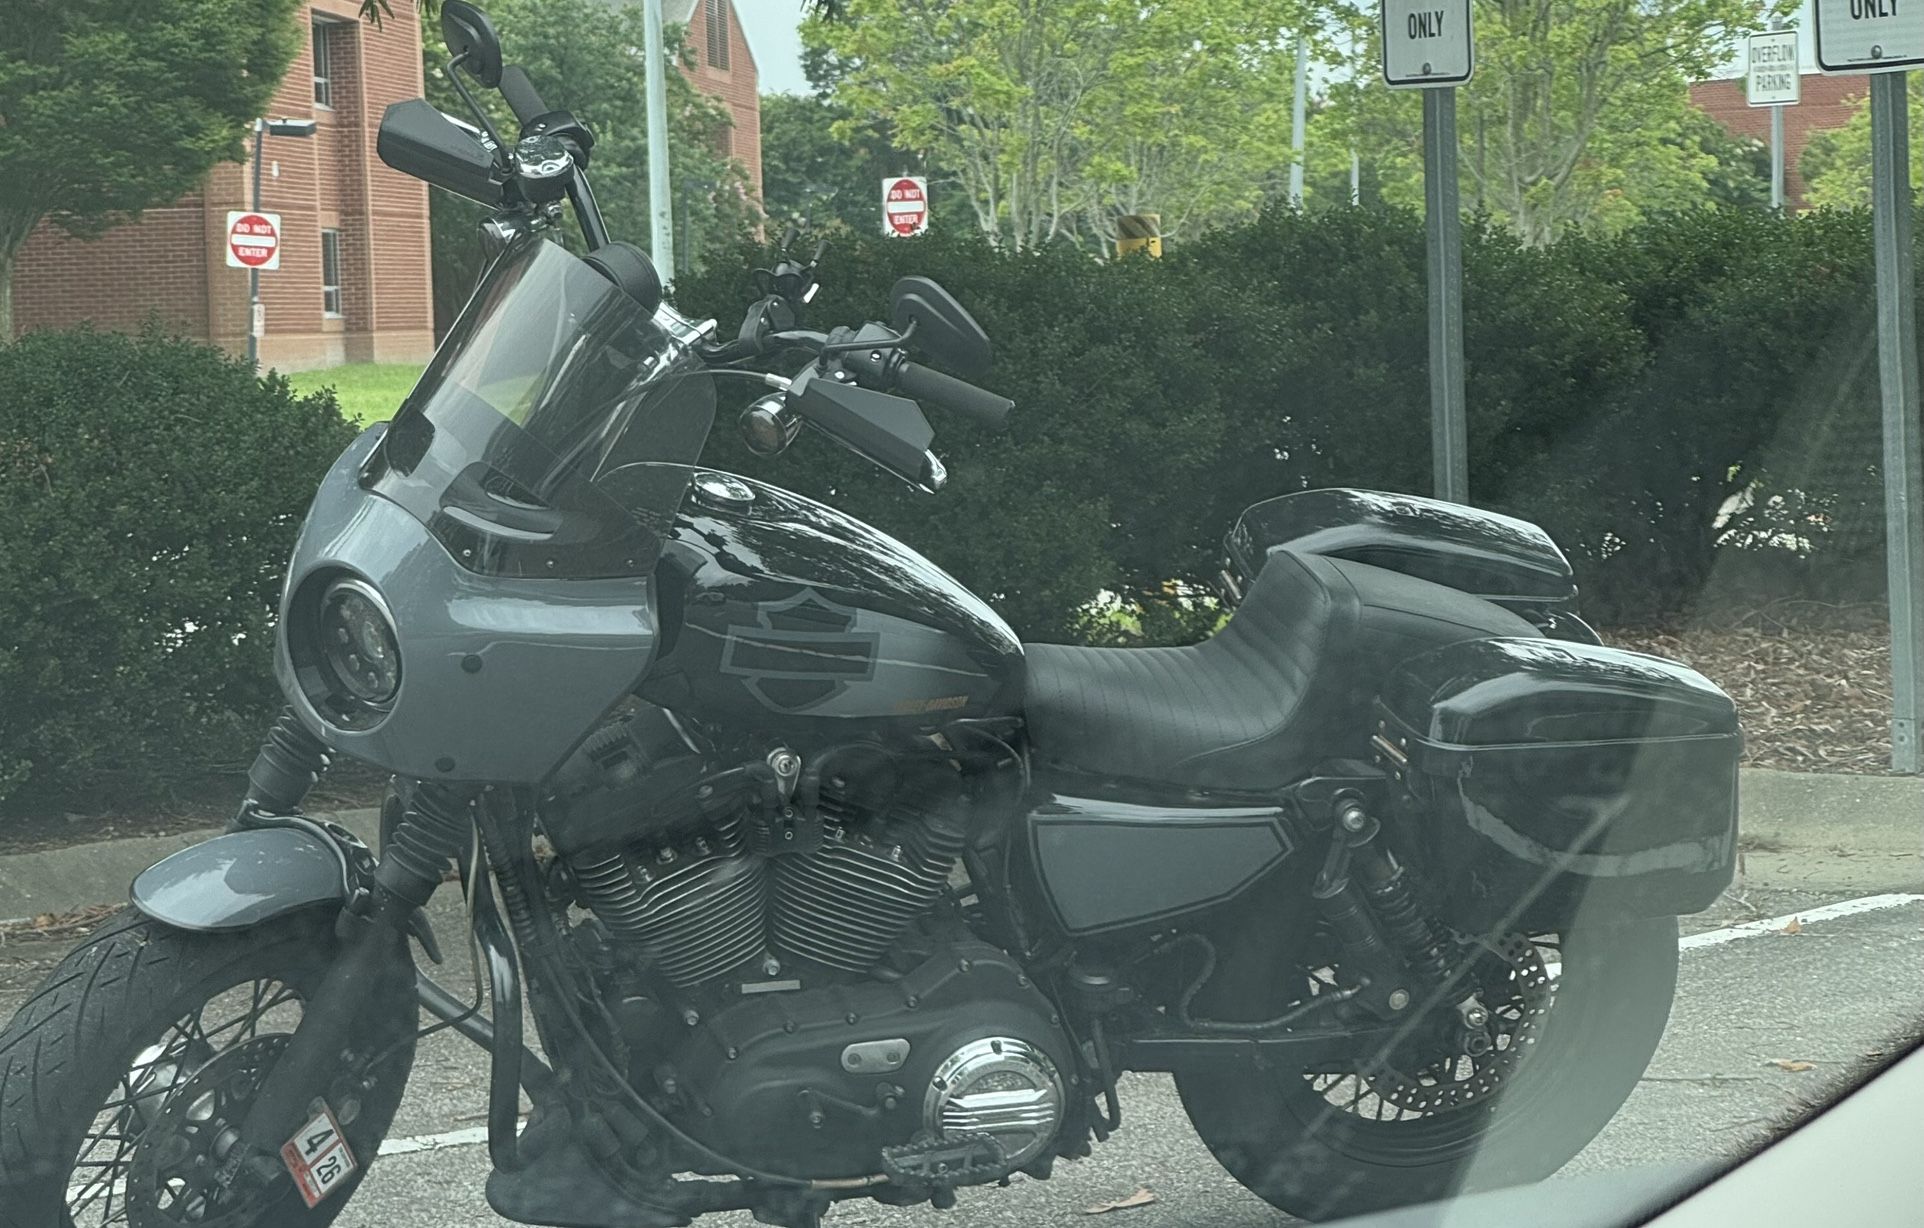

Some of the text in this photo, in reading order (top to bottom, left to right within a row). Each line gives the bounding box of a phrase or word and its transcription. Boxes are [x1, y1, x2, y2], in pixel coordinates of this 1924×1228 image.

[1850, 0, 1897, 20] ONLY
[1408, 10, 1444, 40] ONLY
[1752, 44, 1795, 64] OVERFLOW
[1756, 73, 1791, 92] PARKING
[890, 188, 920, 200] DO NOT
[236, 223, 272, 235] DO NOT
[894, 214, 919, 225] ENTER
[238, 246, 268, 257] ENTER
[305, 1129, 335, 1156] 4
[316, 1156, 341, 1185] 26
